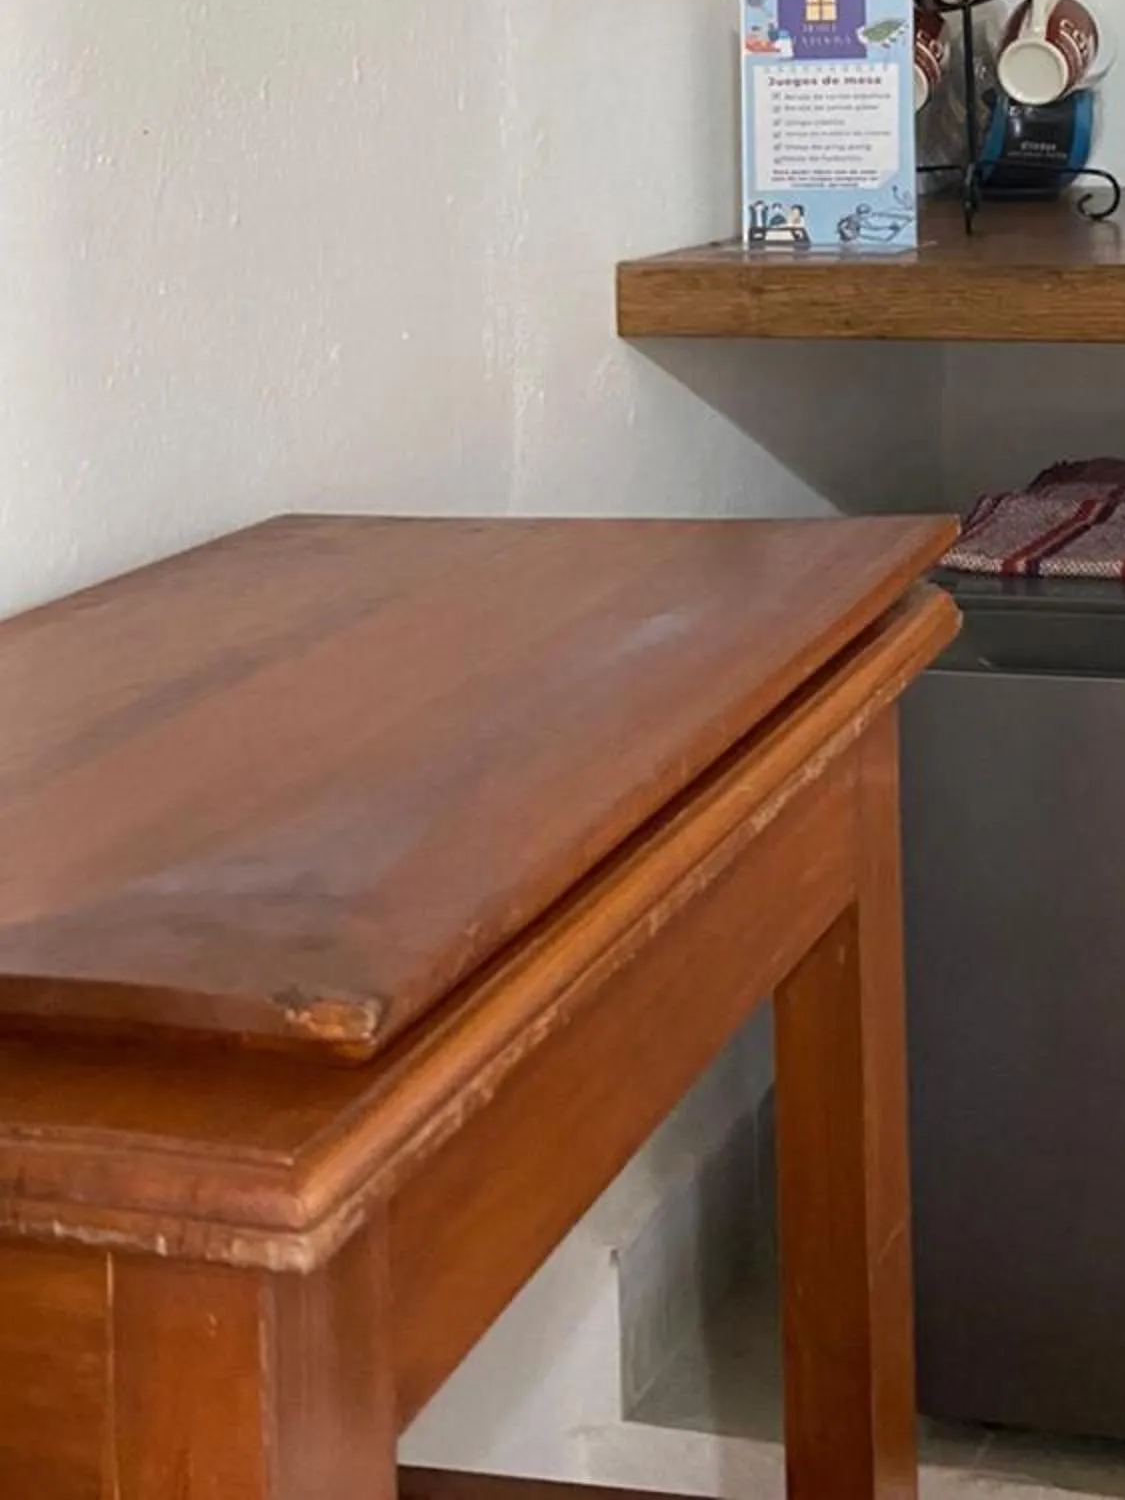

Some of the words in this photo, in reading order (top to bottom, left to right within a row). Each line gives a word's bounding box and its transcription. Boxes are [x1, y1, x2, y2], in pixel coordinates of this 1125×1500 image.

[767, 76, 818, 88] Juegos
[822, 75, 841, 86] de
[843, 75, 882, 86] mesa
